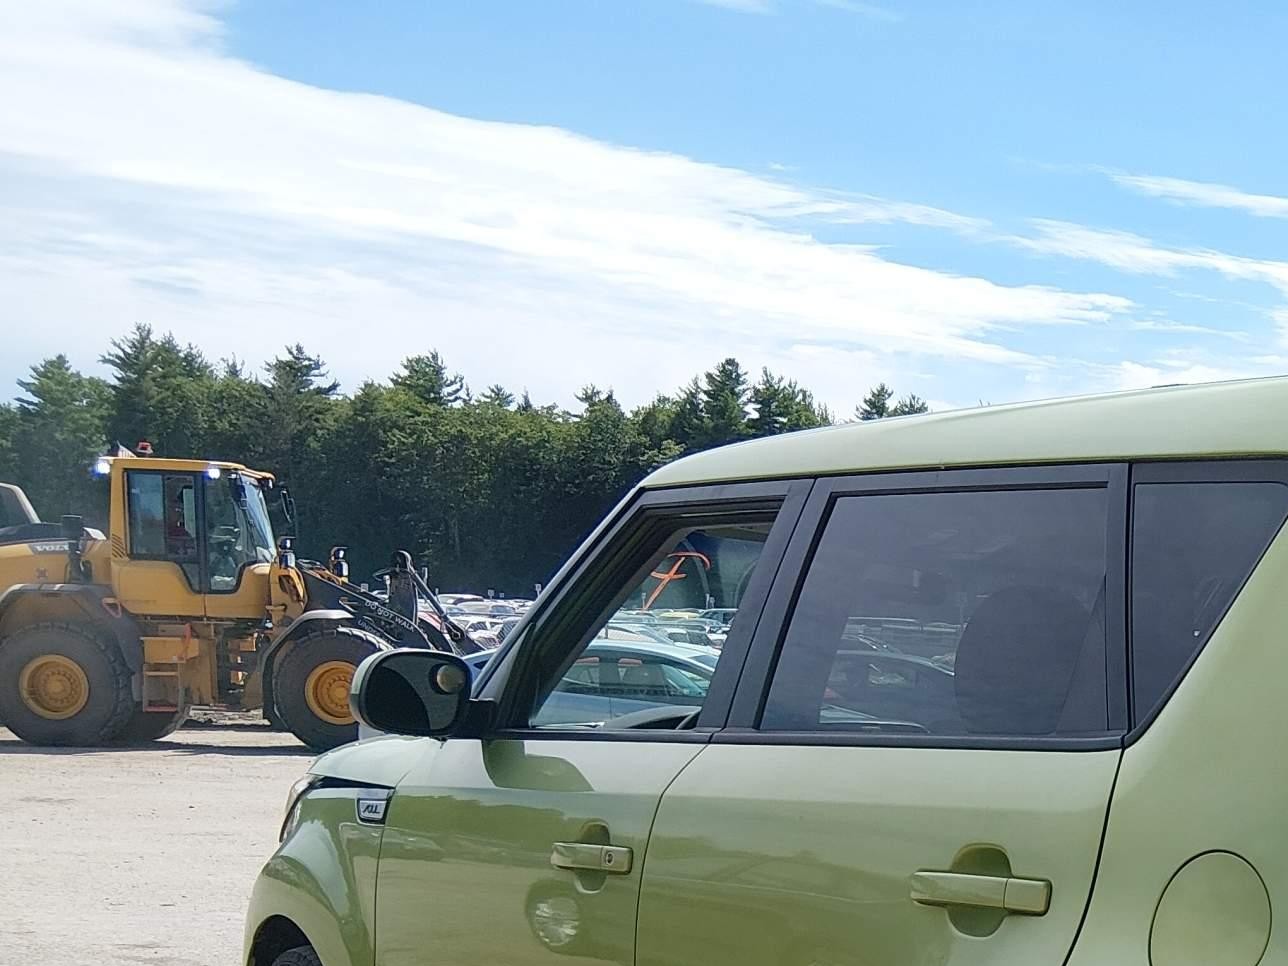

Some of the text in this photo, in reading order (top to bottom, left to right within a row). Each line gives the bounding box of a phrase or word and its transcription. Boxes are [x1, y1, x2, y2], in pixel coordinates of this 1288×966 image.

[364, 601, 414, 633] DO NOT WALK
